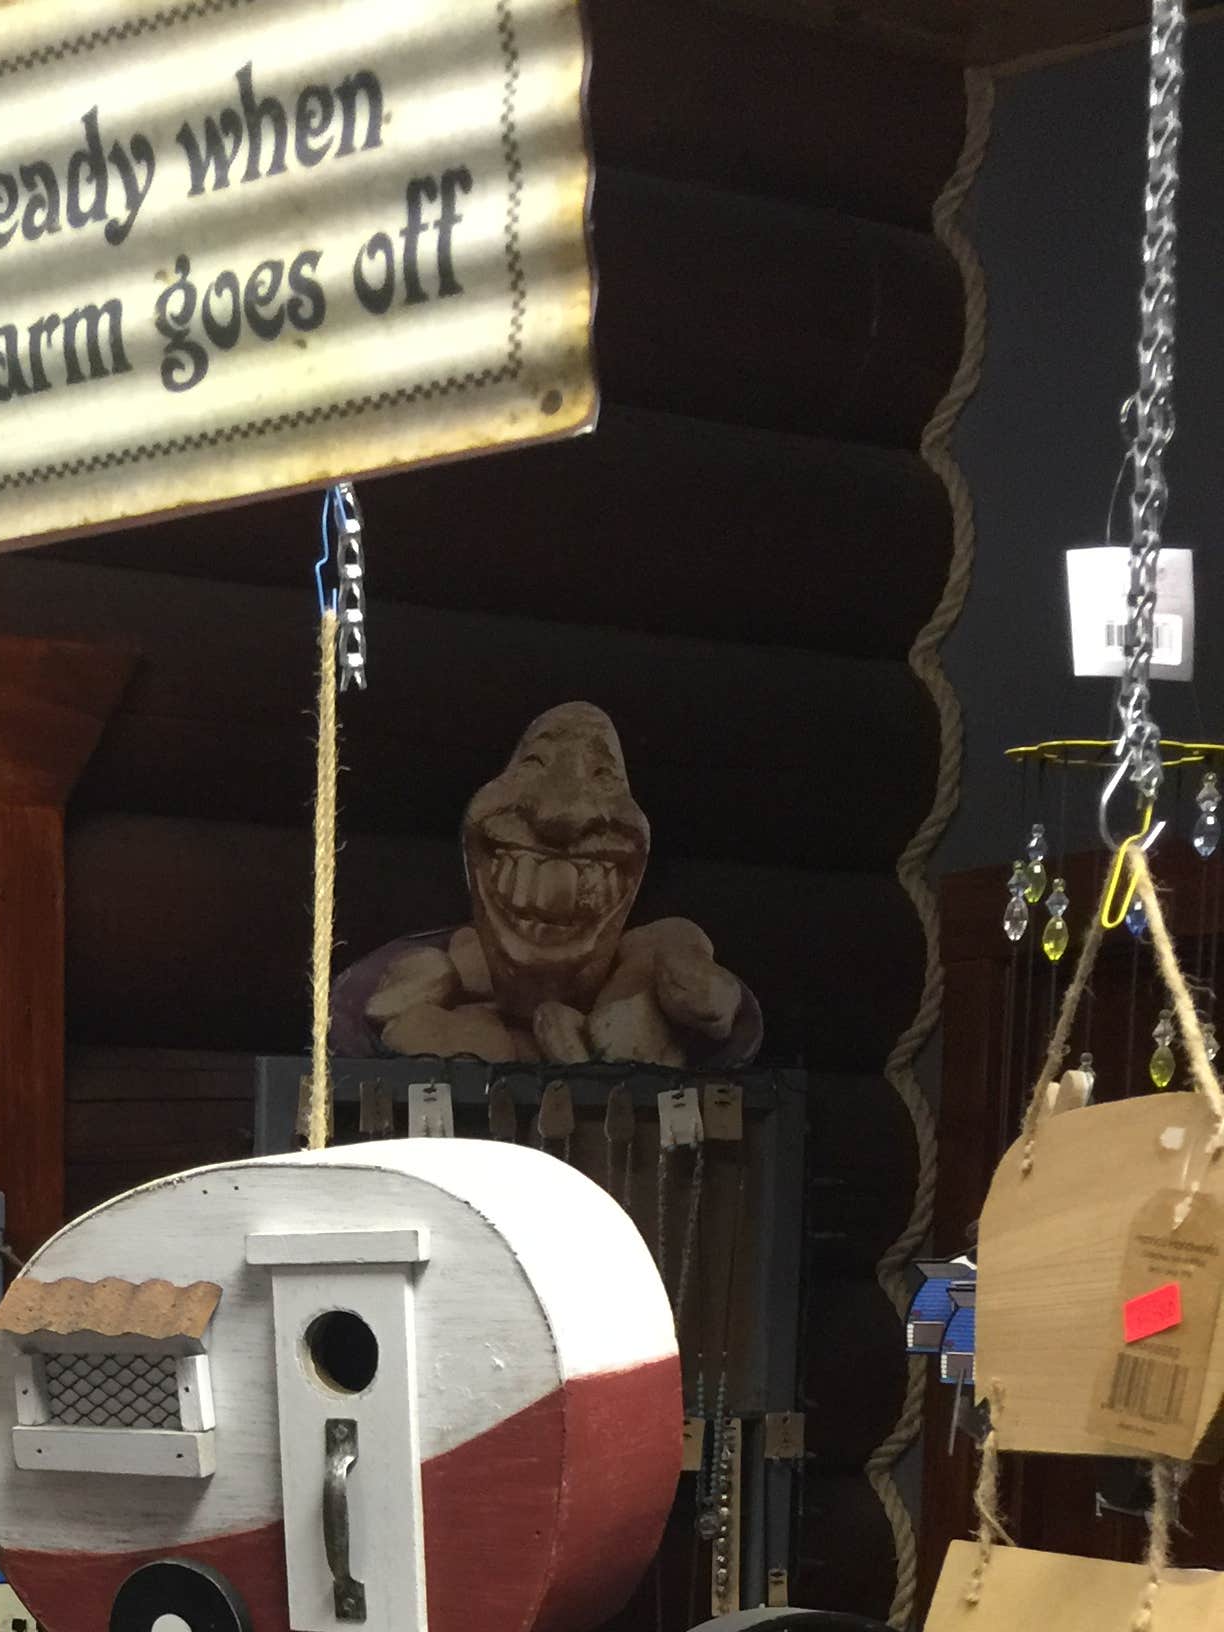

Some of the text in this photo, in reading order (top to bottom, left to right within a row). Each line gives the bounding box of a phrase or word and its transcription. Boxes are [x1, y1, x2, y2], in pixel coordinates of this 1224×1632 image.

[178, 62, 385, 197] when
[154, 246, 327, 392] goes
[352, 165, 474, 315] off
